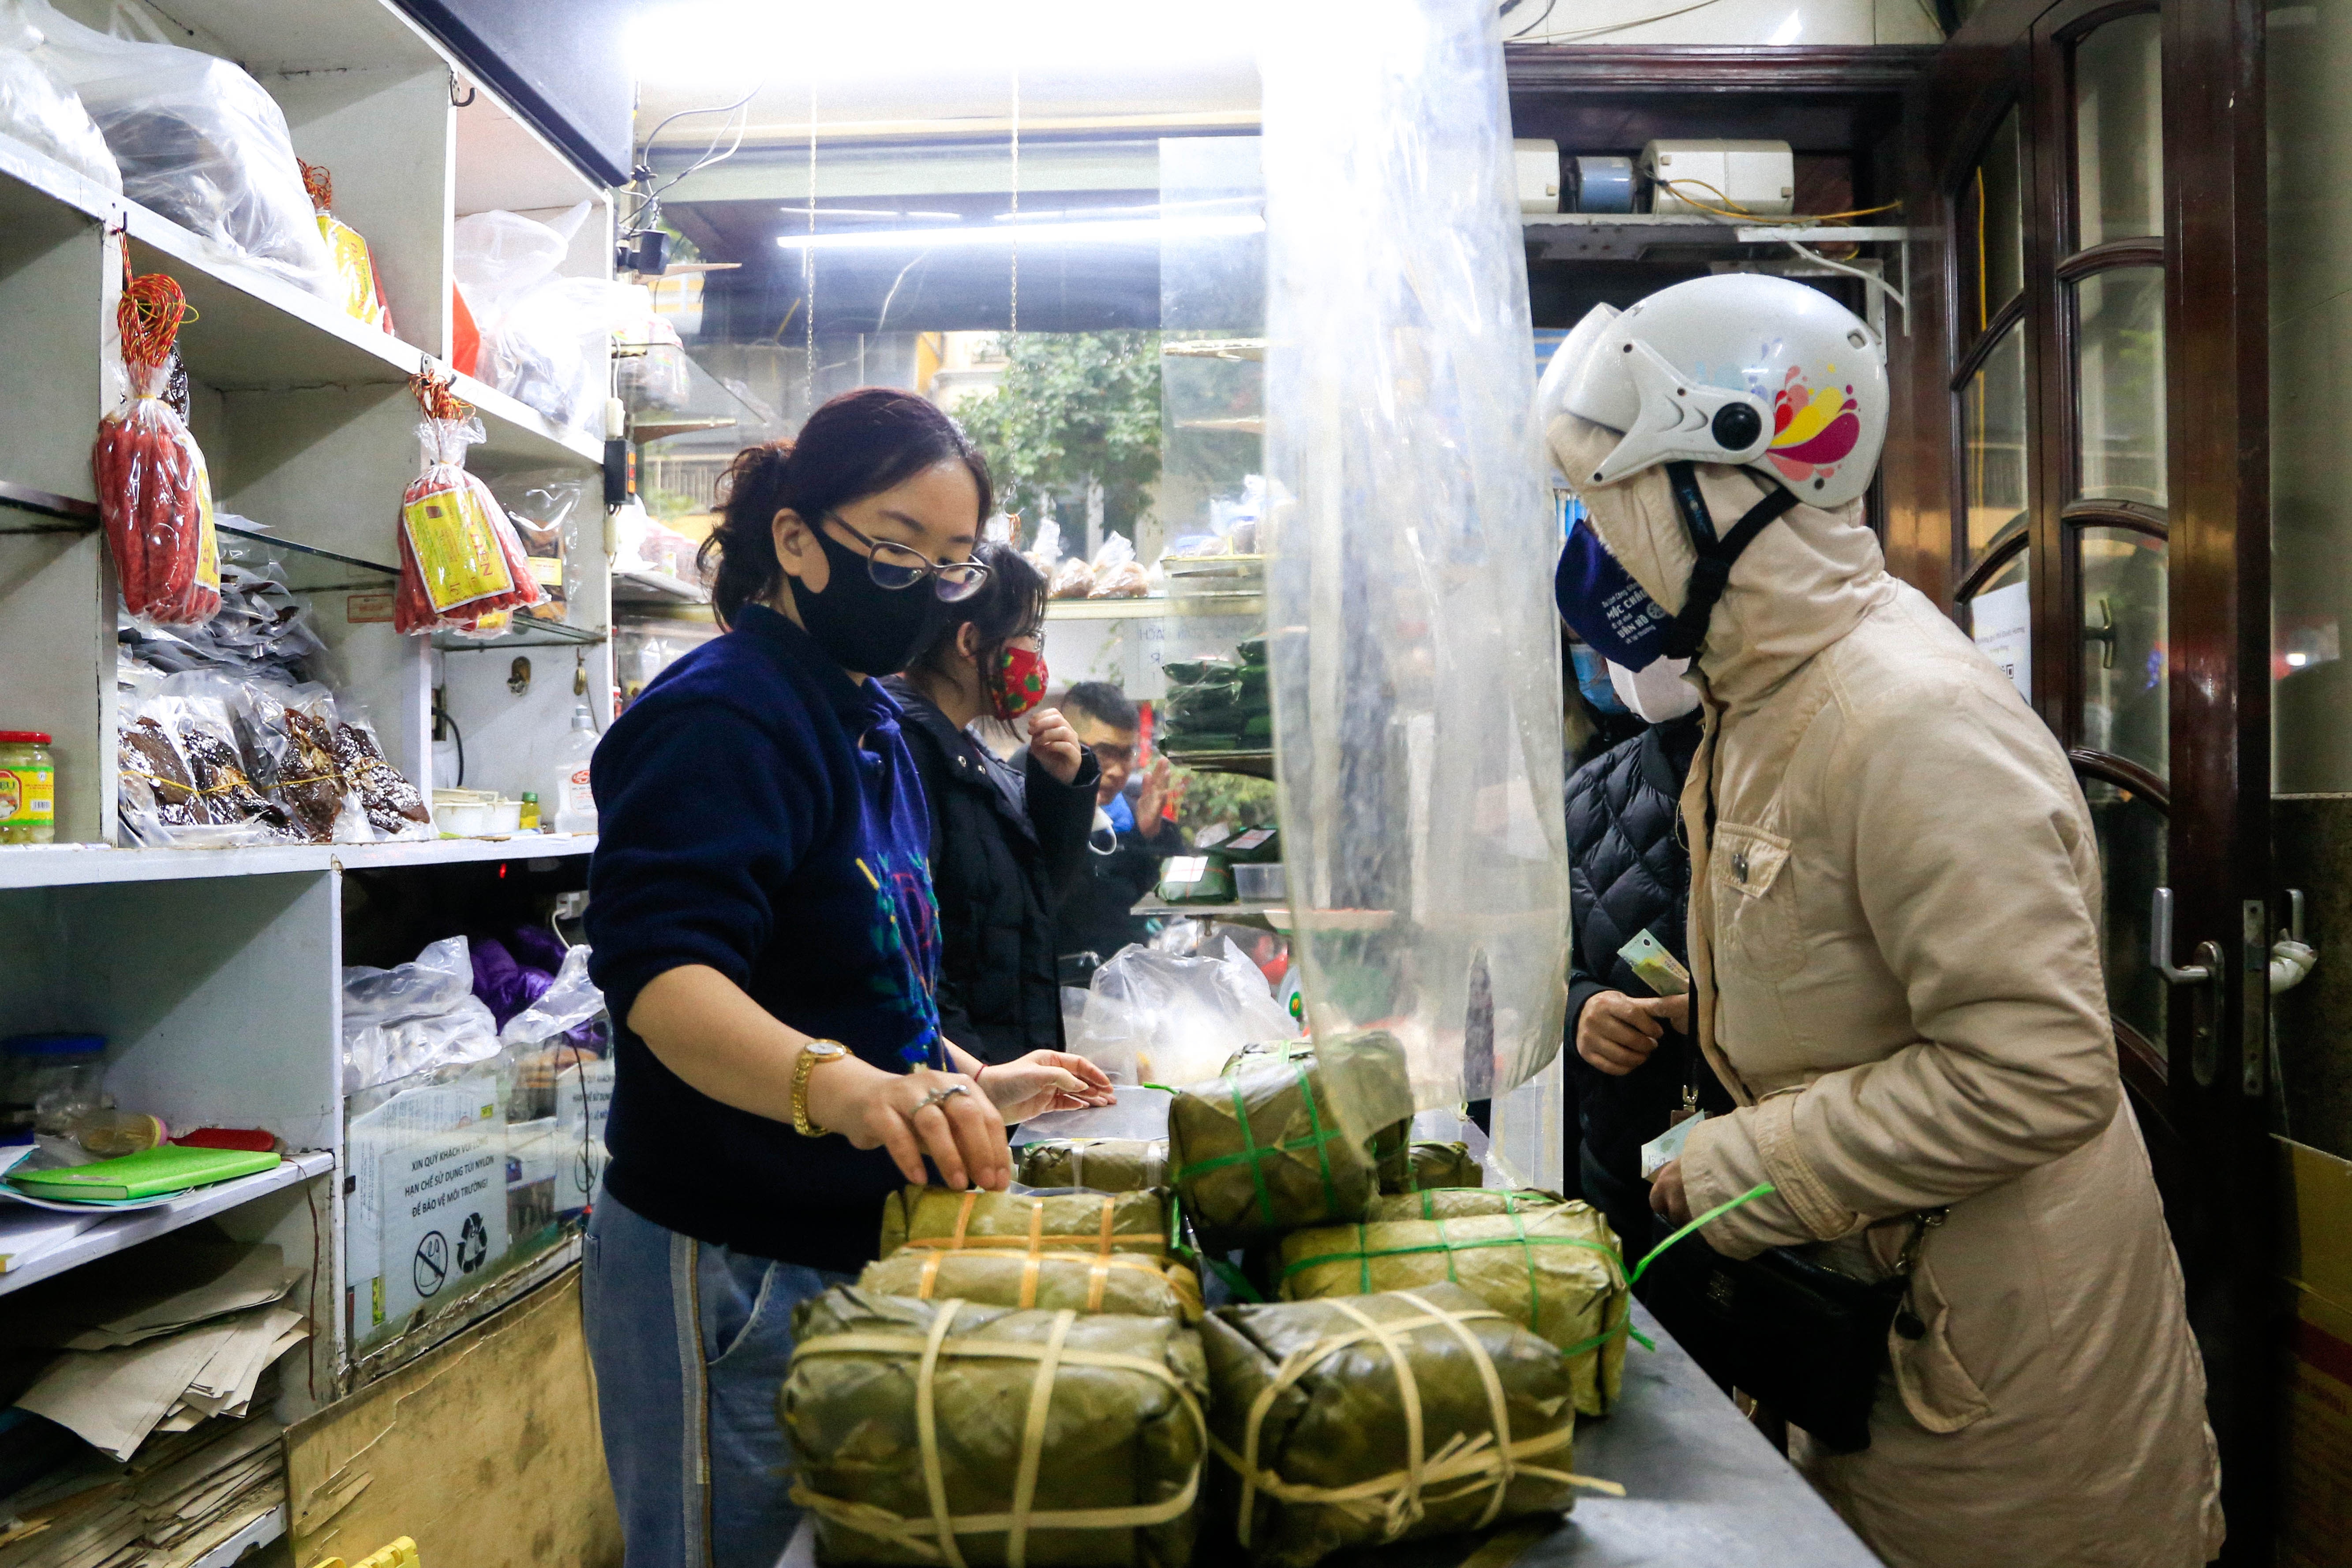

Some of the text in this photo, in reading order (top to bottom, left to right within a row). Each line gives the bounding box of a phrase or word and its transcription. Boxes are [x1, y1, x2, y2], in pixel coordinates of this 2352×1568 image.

[412, 1159, 423, 1172] XIN
[424, 1151, 438, 1167] QUÝ
[439, 1145, 460, 1162] KHÁCH
[405, 1155, 494, 1198] HẠN CHẾ SỬ DỤNG TÚI NYLON
[423, 1198, 436, 1213] BẢO
[438, 1193, 445, 1207] VỆ
[447, 1188, 459, 1203] MÔI
